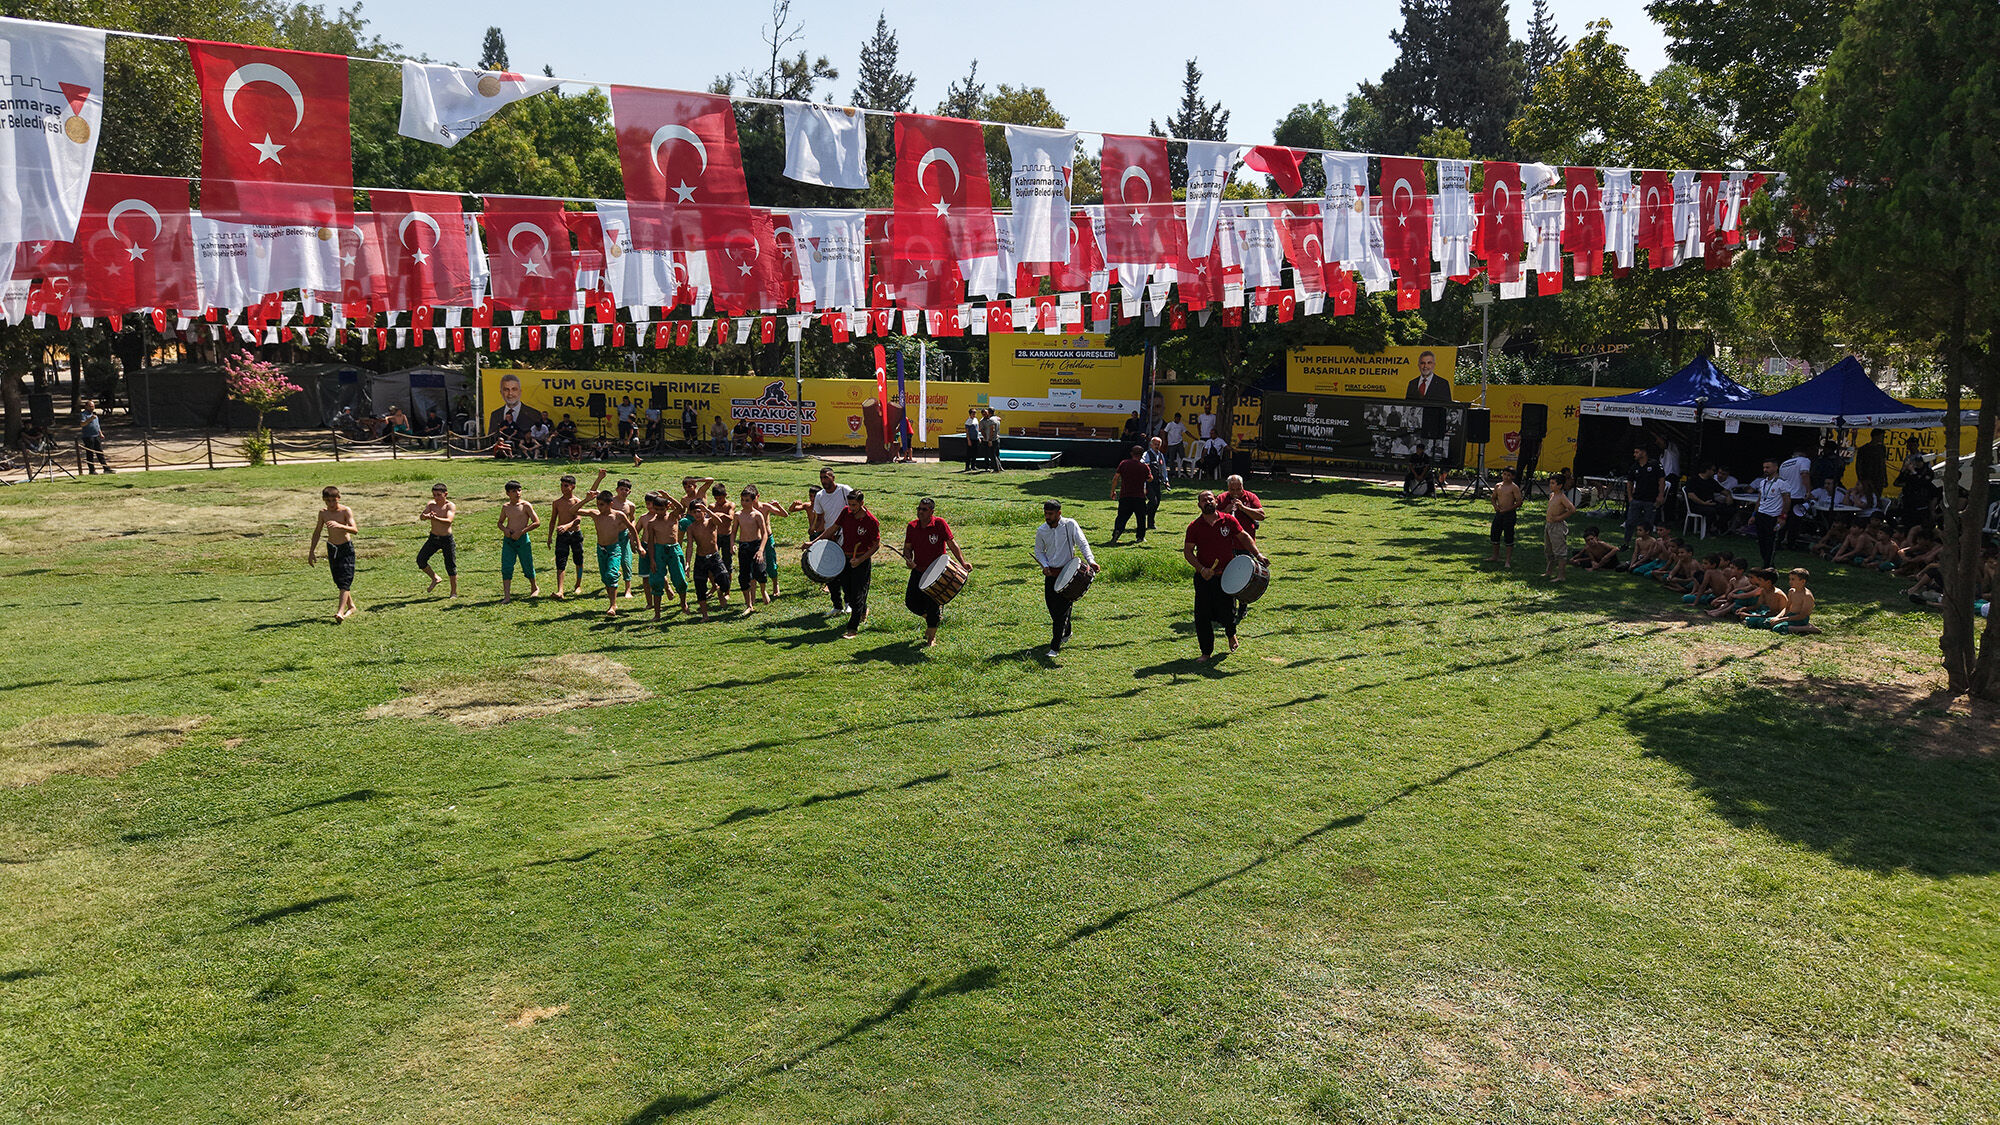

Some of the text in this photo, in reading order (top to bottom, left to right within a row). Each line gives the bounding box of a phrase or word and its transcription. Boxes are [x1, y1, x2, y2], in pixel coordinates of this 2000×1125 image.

[9, 115, 63, 135] Belediyesi
[1303, 366, 1357, 376] BAŞARILAR
[733, 407, 816, 420] KARAKUCAK
[1019, 427, 1096, 437] 3 1 2
